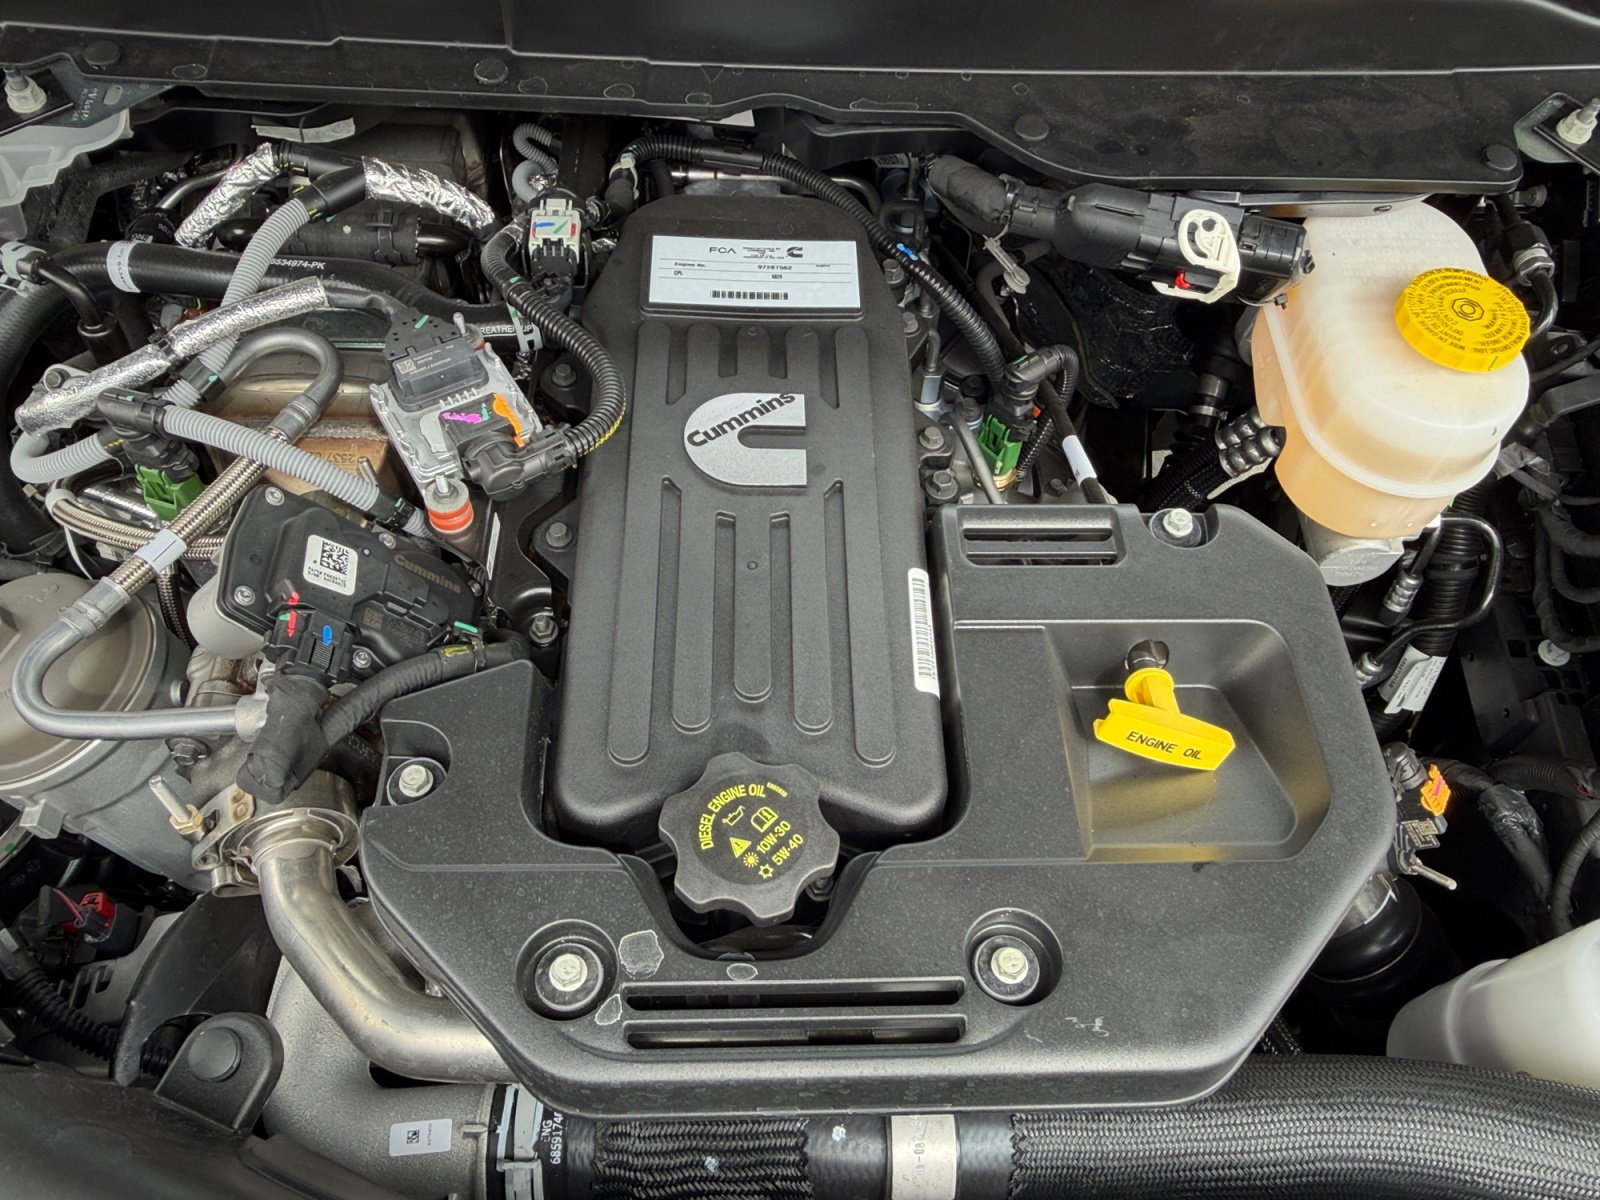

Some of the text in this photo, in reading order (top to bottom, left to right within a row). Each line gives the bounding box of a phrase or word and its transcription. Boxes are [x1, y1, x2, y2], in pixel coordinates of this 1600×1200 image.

[687, 393, 796, 447] Cummins
[394, 554, 461, 593] Cummins
[1126, 731, 1203, 761] ENGINE OIL
[699, 783, 766, 850] DIESEL ENGINE OIL
[541, 1119, 552, 1142] ENG
